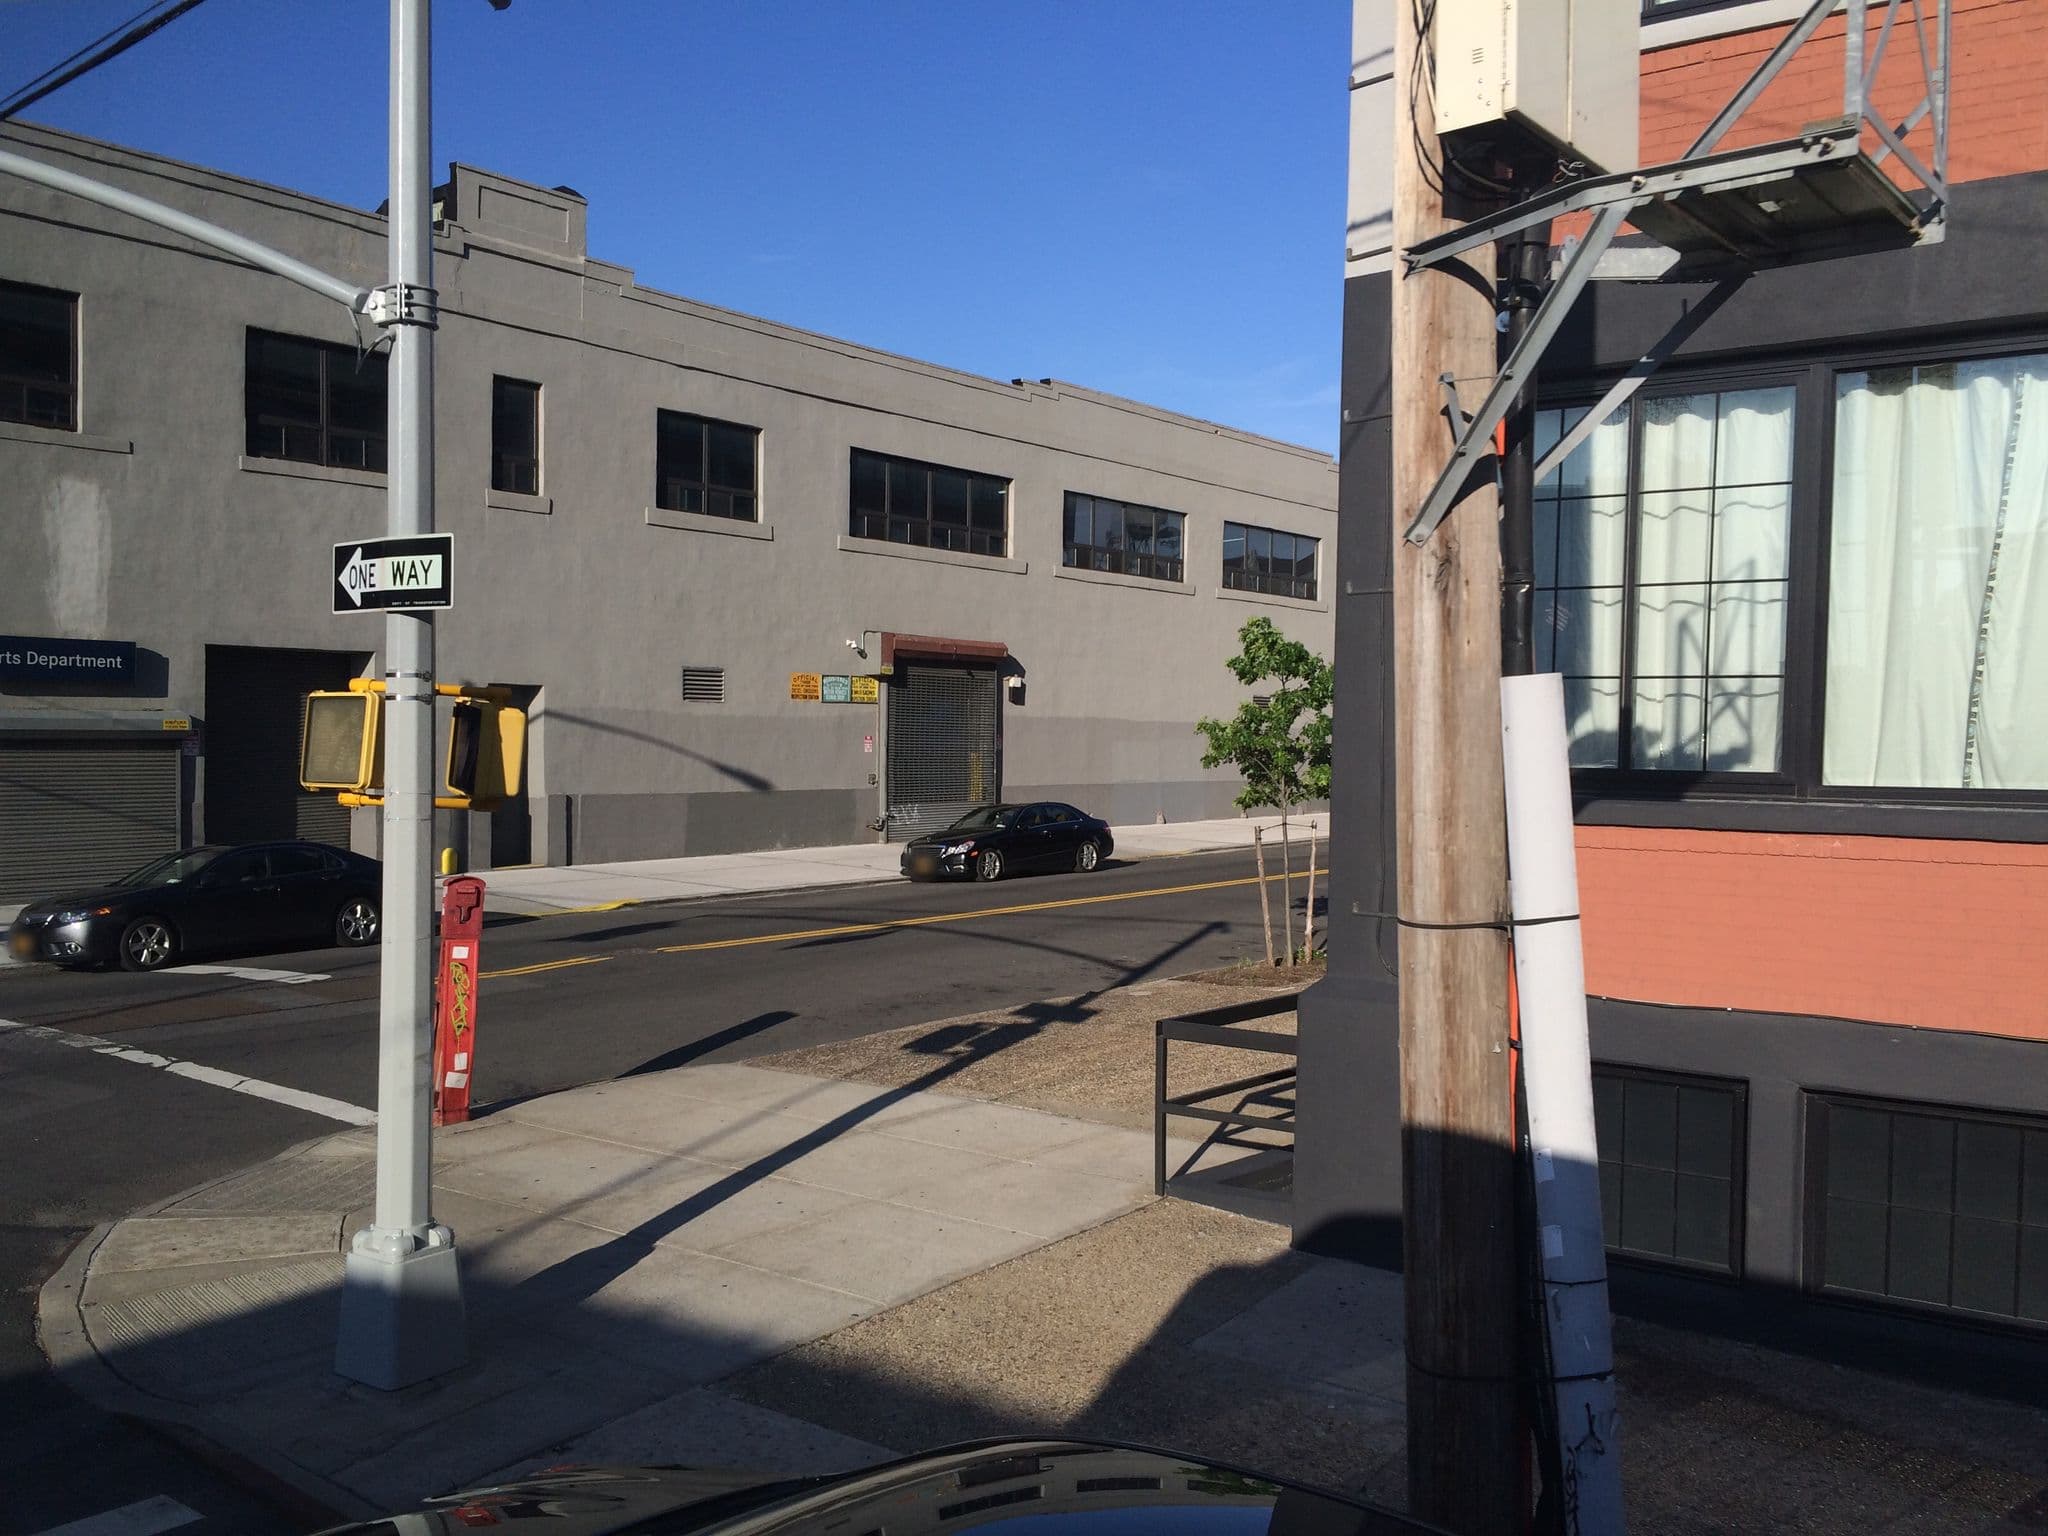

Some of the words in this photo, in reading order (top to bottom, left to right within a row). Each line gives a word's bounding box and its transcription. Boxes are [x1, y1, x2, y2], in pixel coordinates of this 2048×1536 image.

[349, 563, 376, 590] ONE
[392, 559, 433, 587] WAY
[26, 651, 122, 669] Department
